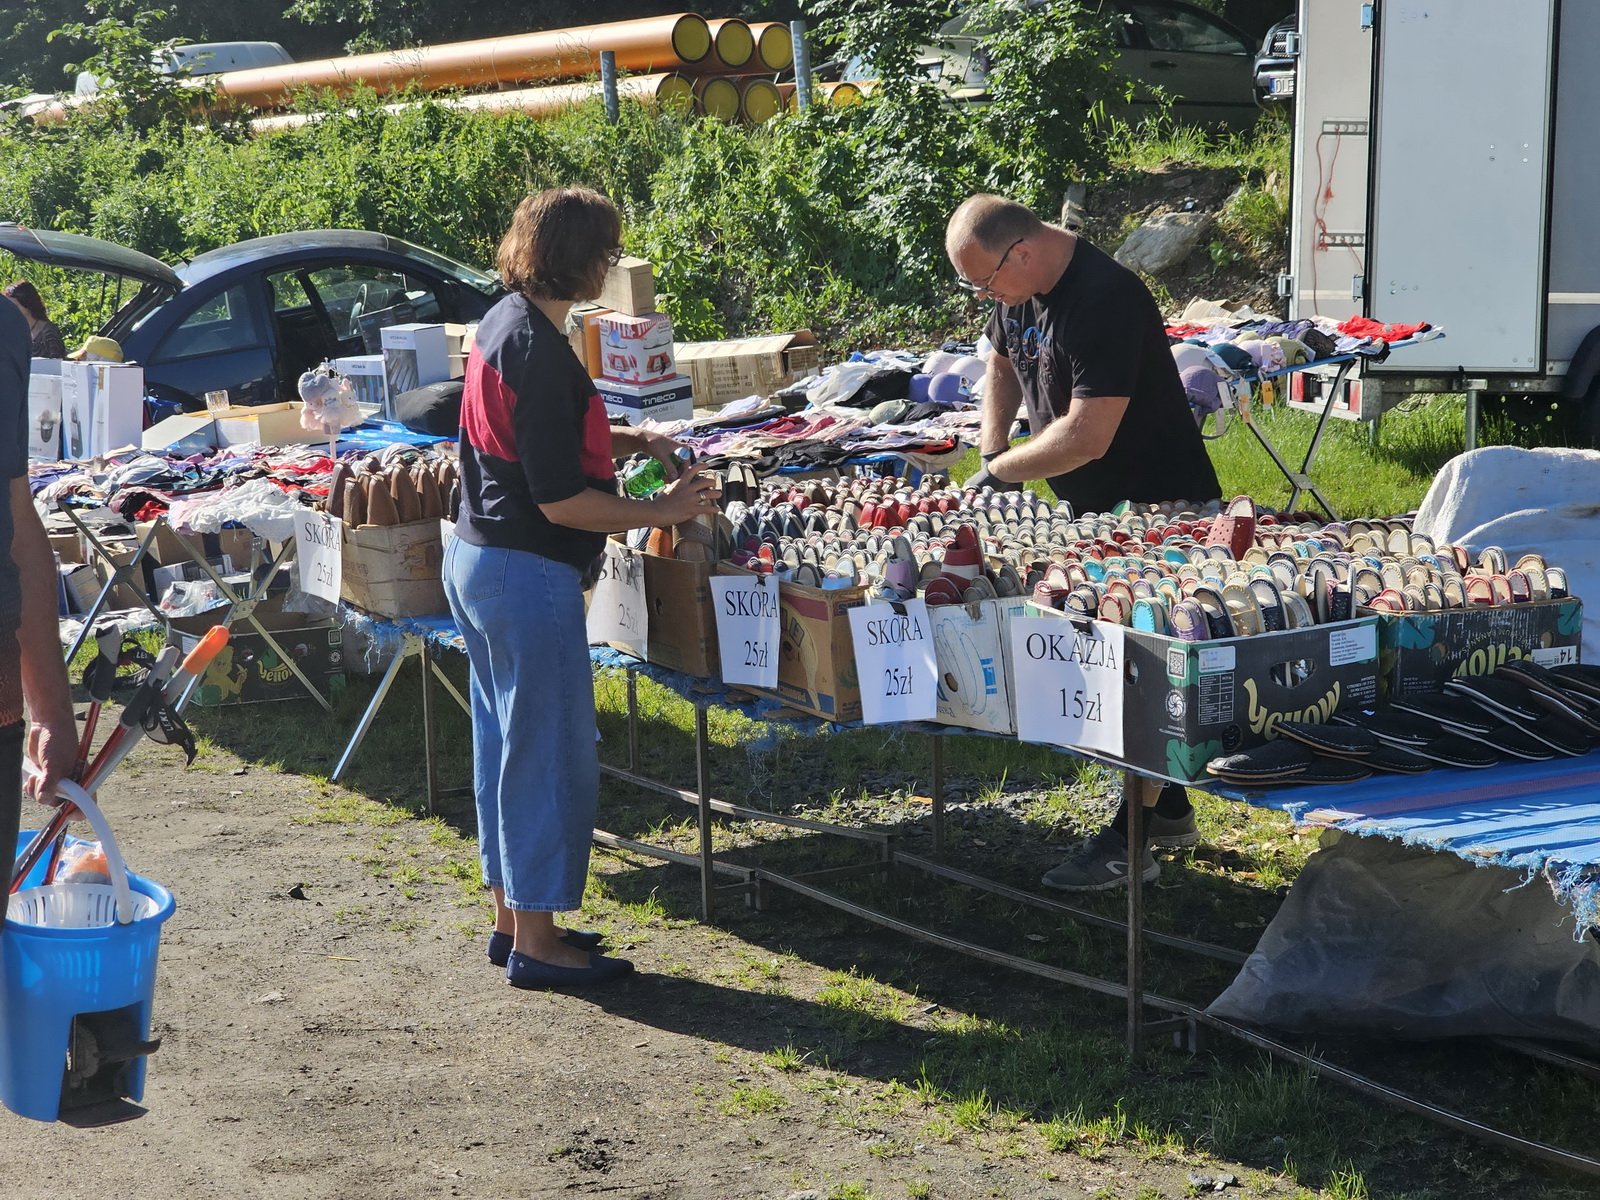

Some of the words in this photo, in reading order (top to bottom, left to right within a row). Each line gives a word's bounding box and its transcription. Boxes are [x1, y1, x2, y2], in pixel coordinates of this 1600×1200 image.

[744, 640, 768, 668] 25zł
[1026, 633, 1118, 670] OKAZJA
[884, 666, 913, 697] 25zł
[1059, 688, 1103, 723] 15zł
